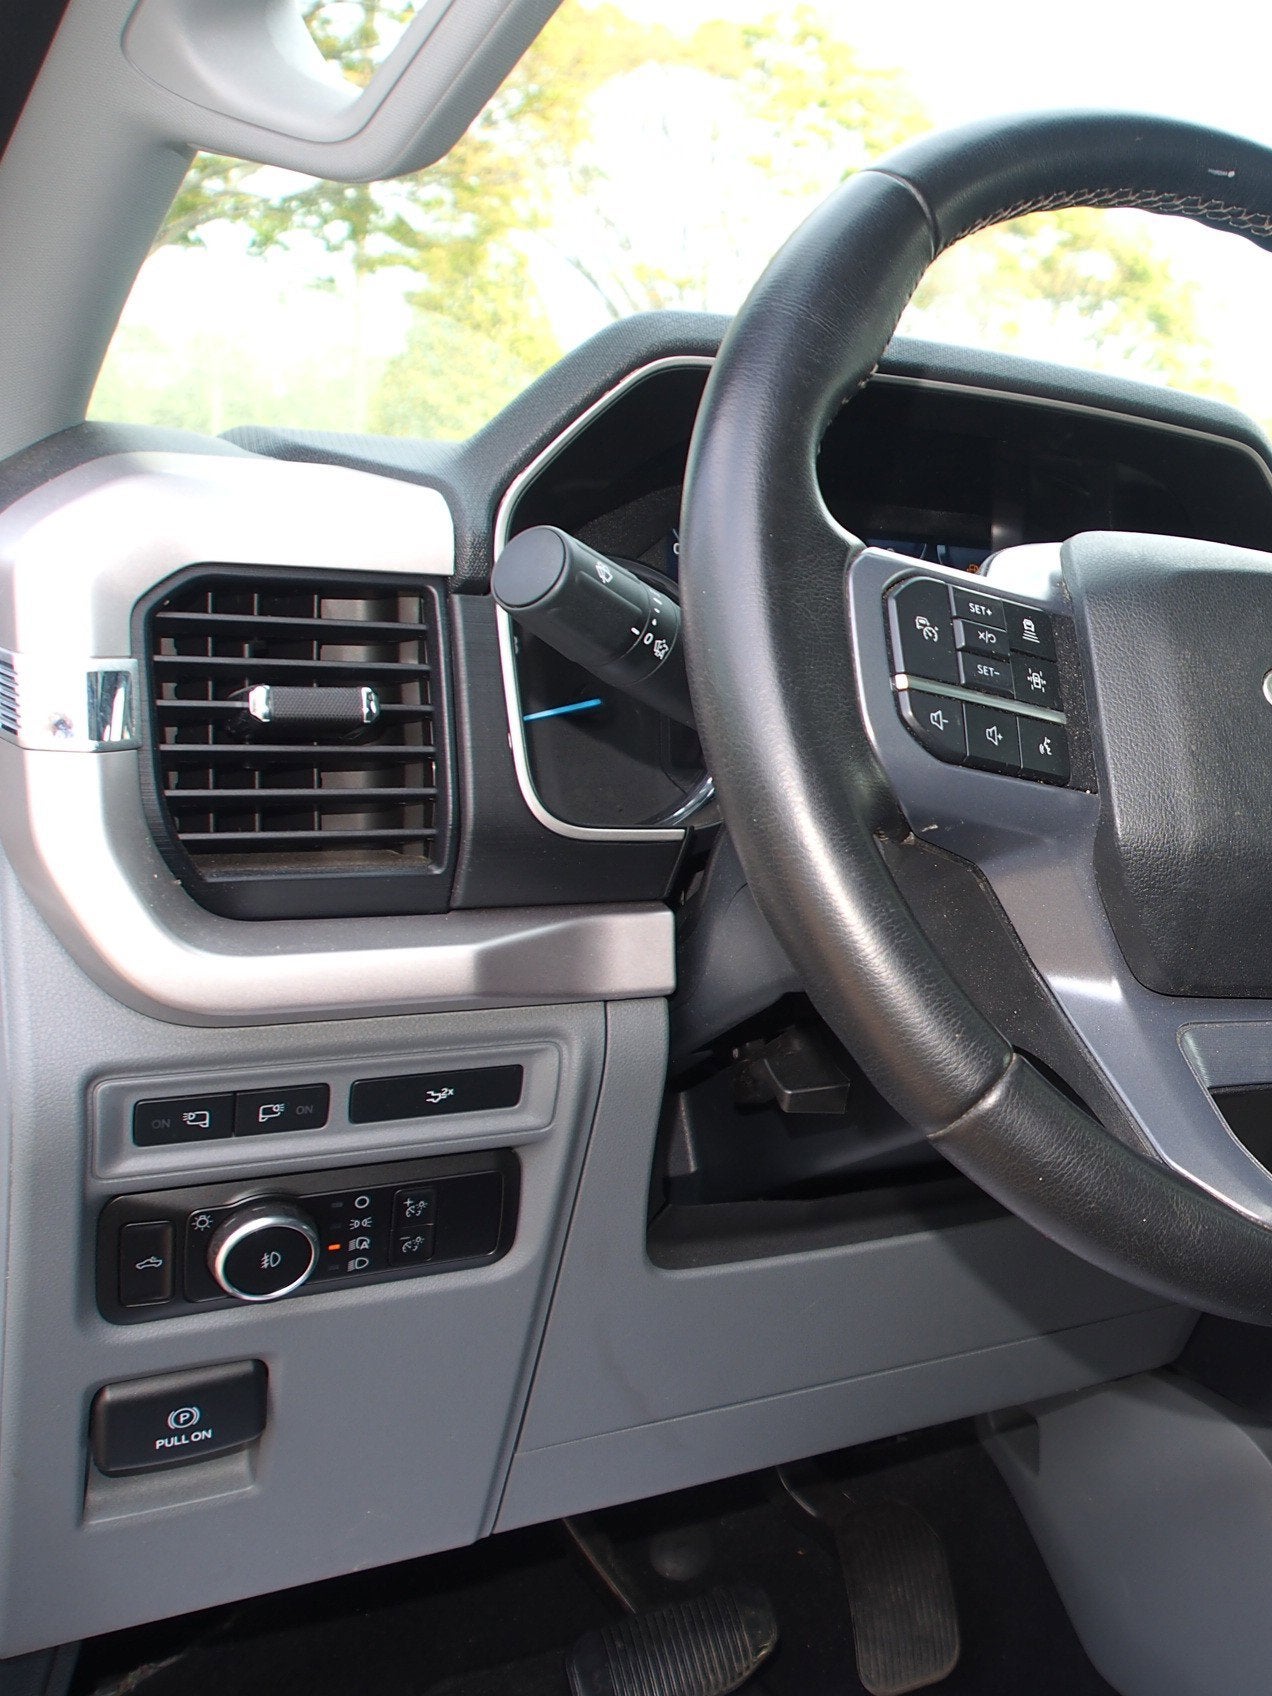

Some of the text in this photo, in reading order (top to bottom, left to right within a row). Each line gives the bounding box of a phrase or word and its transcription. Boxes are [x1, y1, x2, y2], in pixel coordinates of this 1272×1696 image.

[969, 602, 993, 616] SET+
[295, 1105, 314, 1116] ON
[152, 1118, 171, 1130] ON
[179, 1412, 190, 1424] P
[156, 1428, 213, 1450] PULL ON
